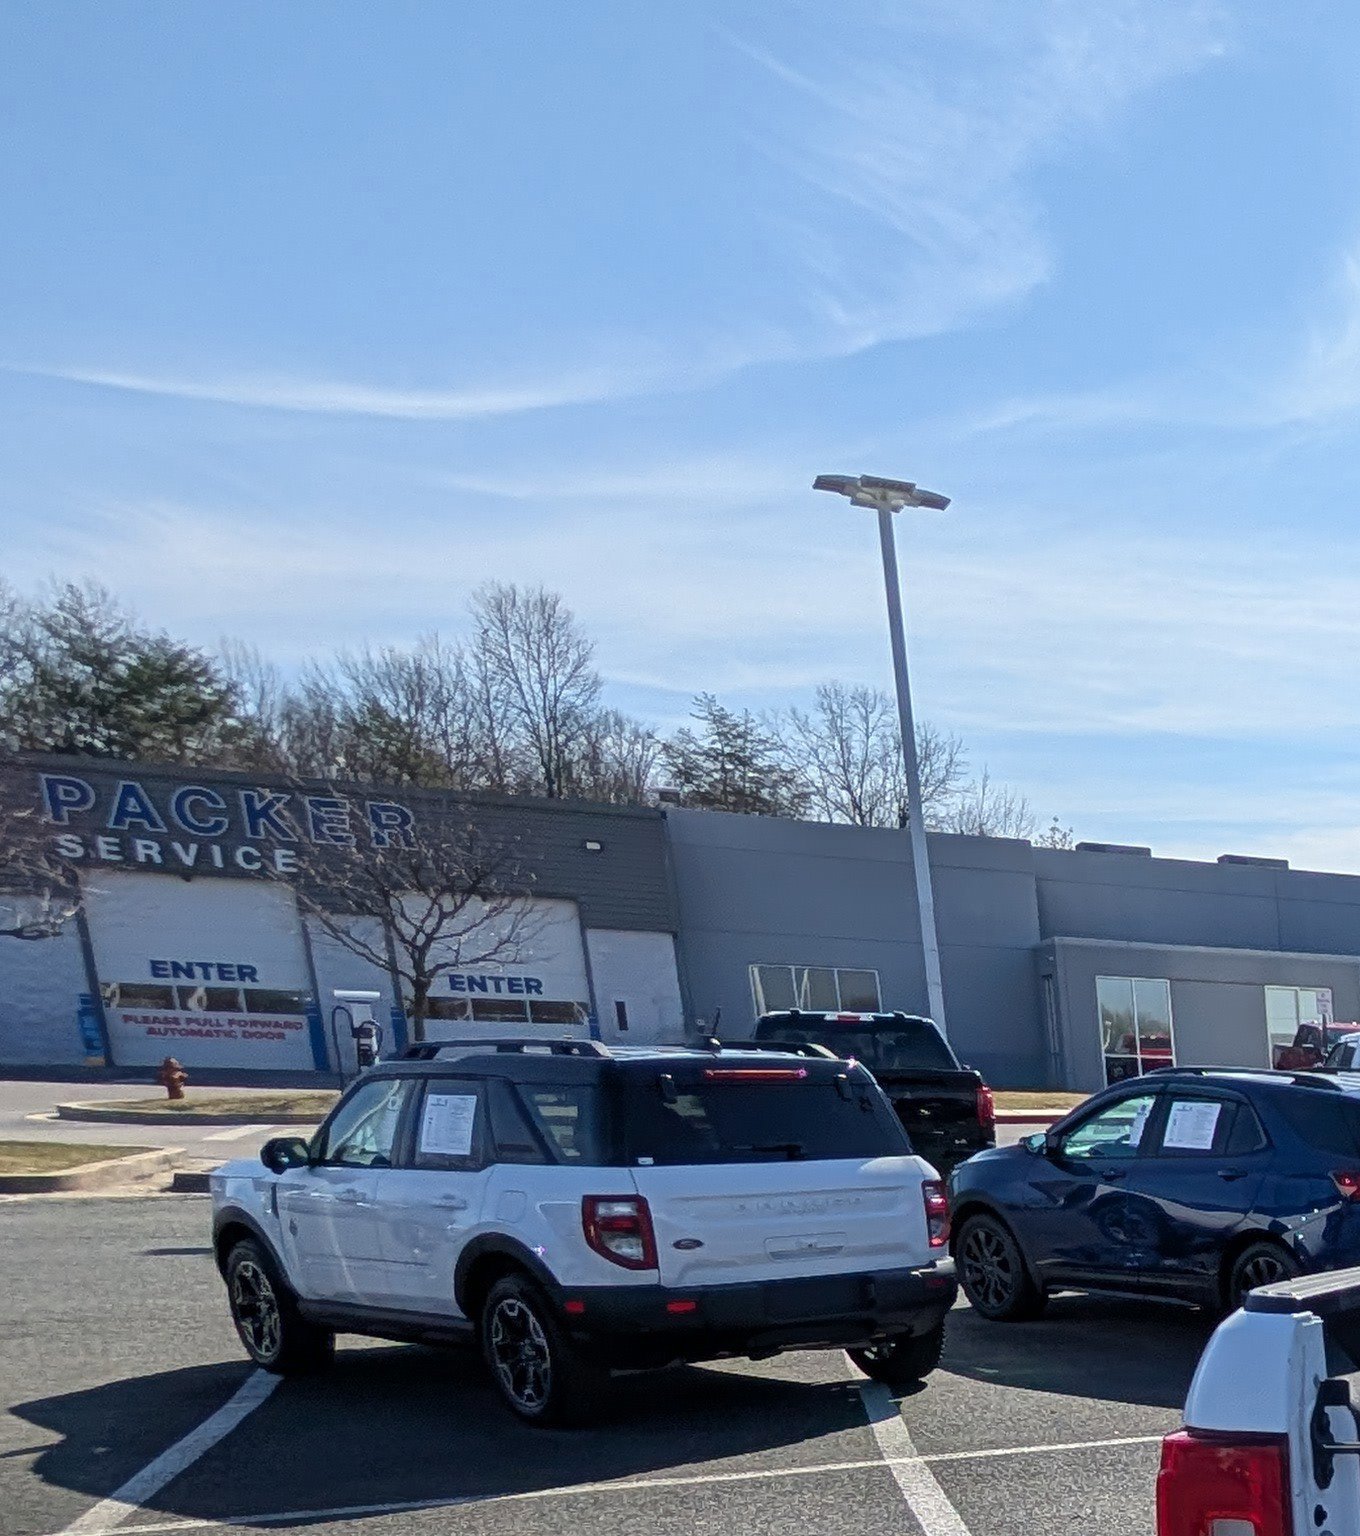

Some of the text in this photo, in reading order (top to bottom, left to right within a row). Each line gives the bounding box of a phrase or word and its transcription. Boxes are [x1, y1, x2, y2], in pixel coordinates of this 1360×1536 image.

[39, 773, 418, 851] PACKER
[54, 833, 299, 873] SERVICE
[149, 959, 259, 984] ENTER
[448, 974, 544, 996] ENTER
[122, 1014, 304, 1031] PLEASE PULL FORWARD
[146, 1027, 287, 1040] AUTOMATIC DOOR
